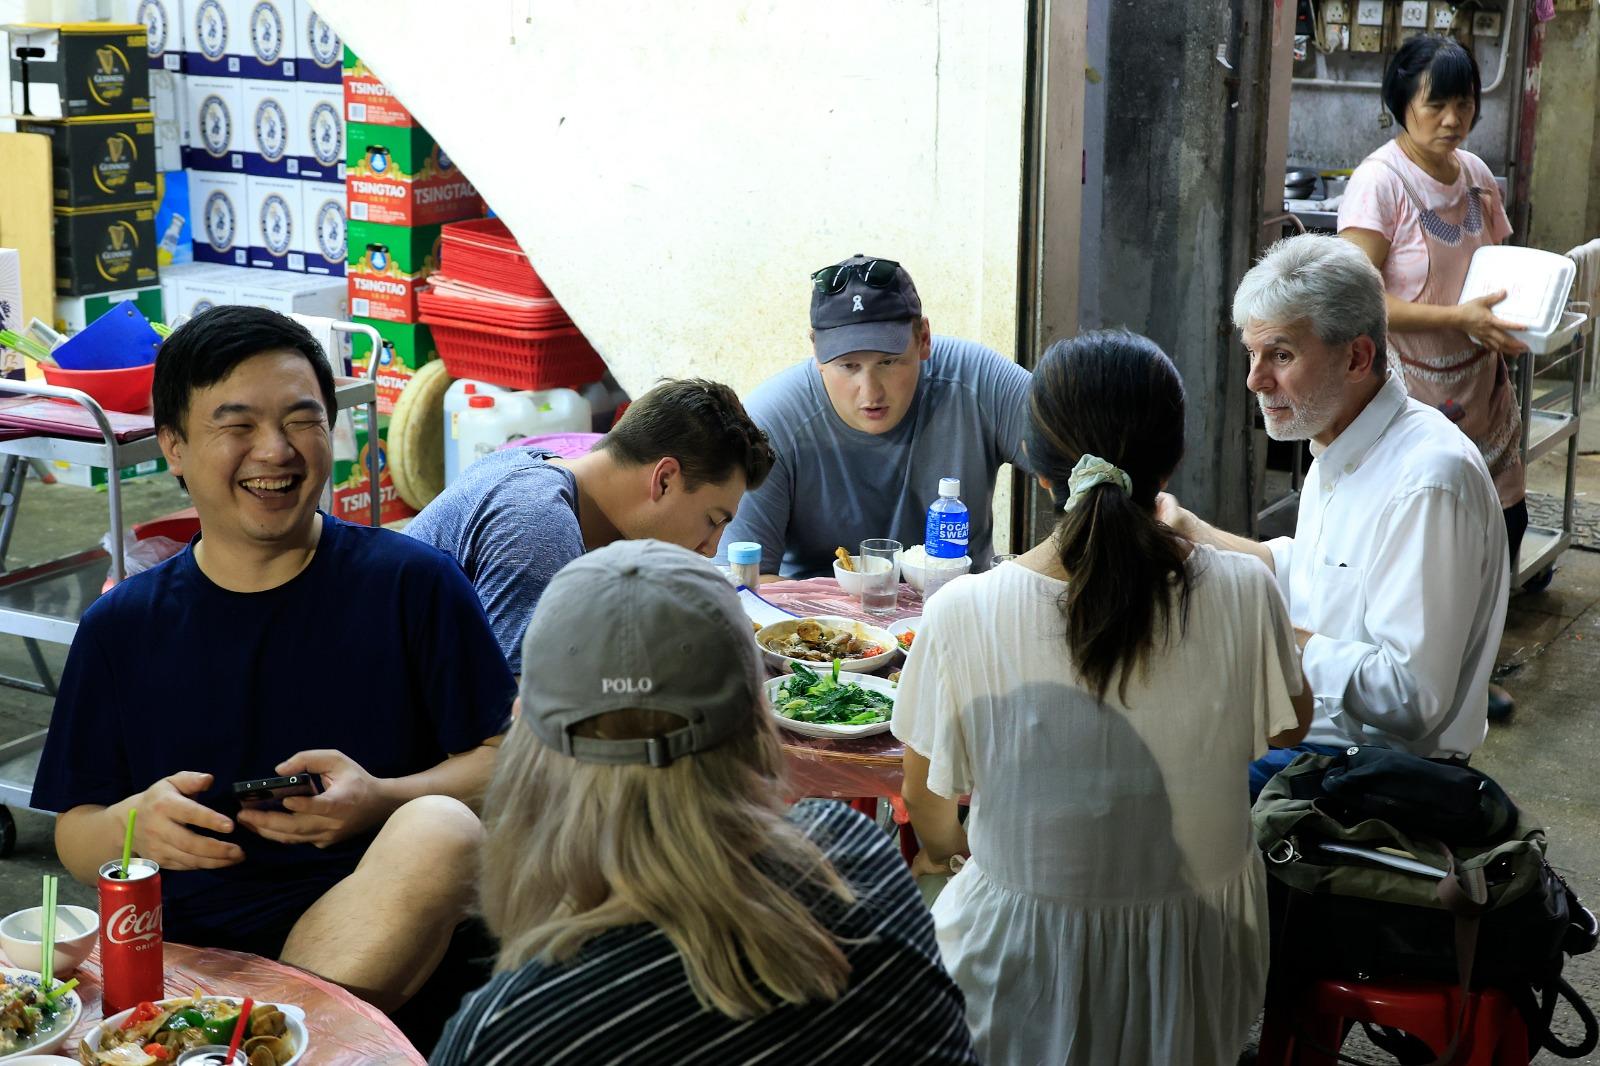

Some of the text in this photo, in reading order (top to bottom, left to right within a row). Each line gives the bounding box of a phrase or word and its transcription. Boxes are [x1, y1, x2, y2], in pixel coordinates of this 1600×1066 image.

[351, 180, 406, 199] TSINGTAO
[353, 277, 406, 297] TSINGTAO
[601, 676, 653, 694] POLO
